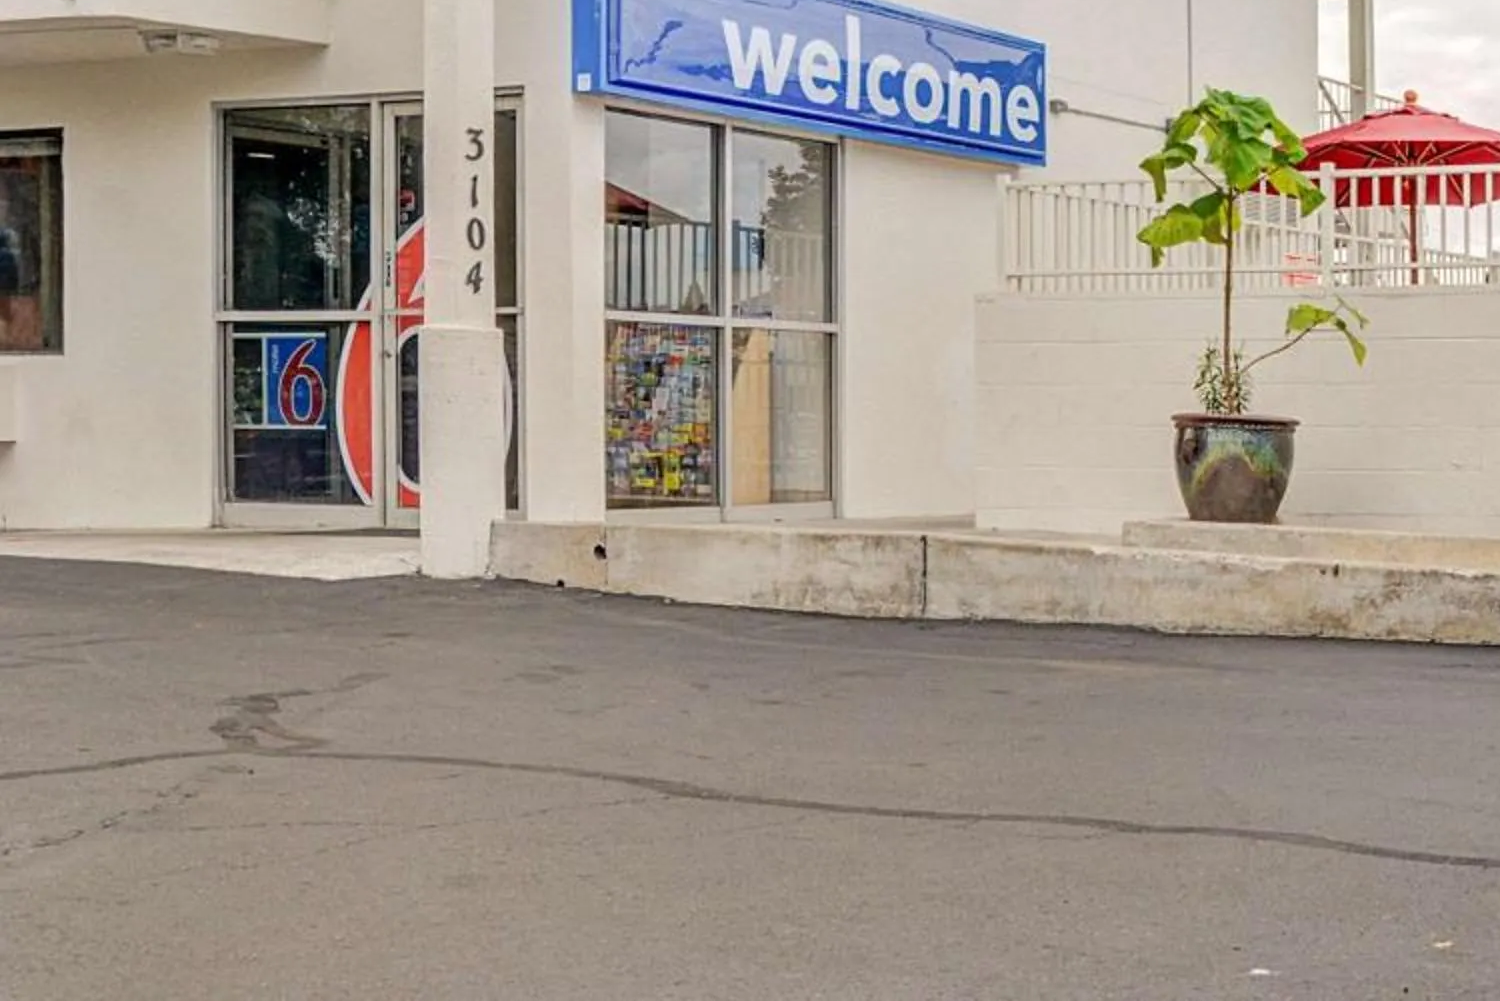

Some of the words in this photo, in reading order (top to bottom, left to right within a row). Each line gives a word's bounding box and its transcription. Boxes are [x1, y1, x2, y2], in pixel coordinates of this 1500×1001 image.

[722, 14, 1040, 143] welcome
[464, 128, 486, 294] 3104
[277, 339, 327, 426] 6
